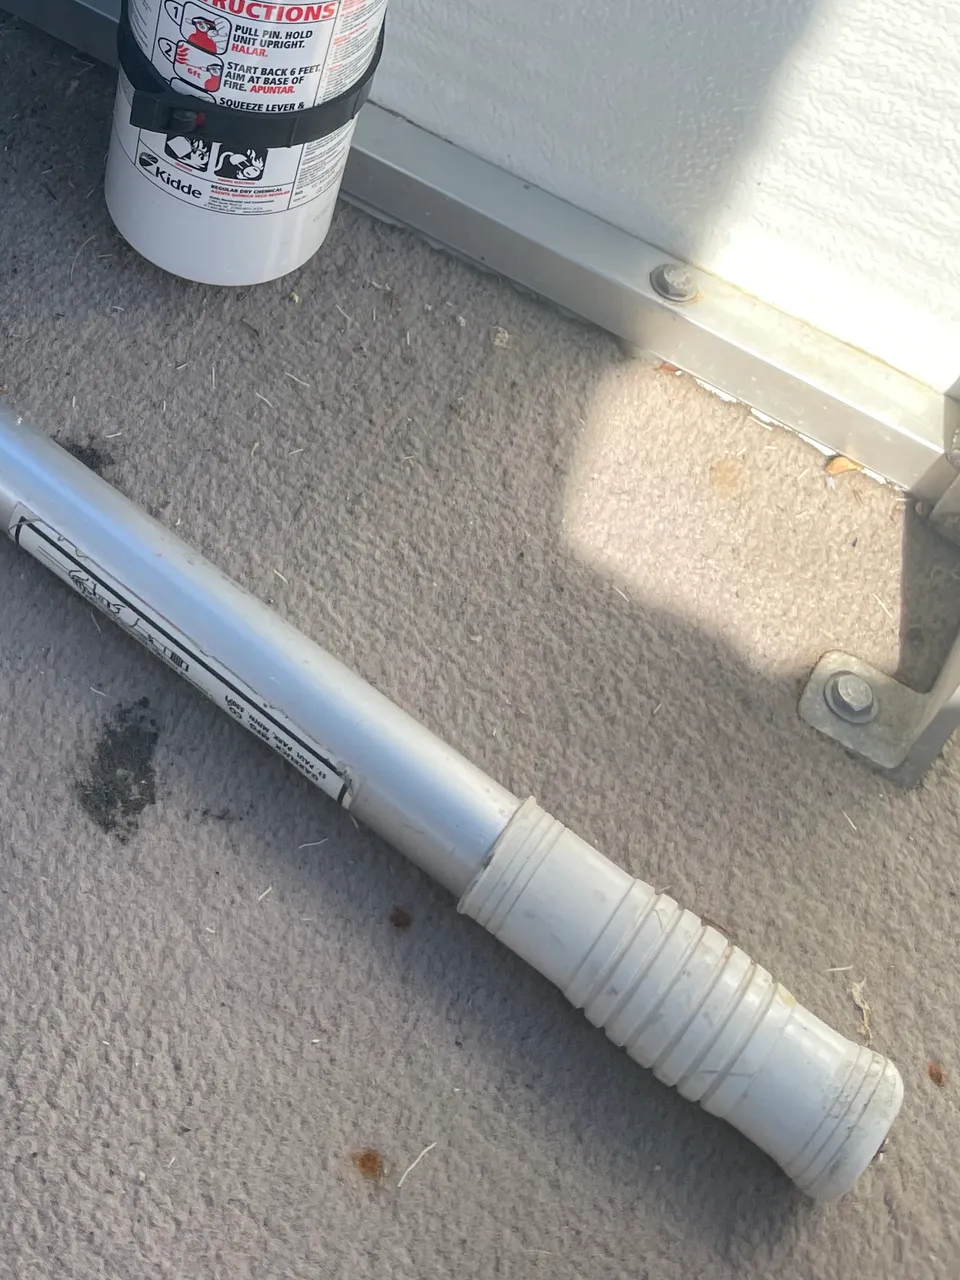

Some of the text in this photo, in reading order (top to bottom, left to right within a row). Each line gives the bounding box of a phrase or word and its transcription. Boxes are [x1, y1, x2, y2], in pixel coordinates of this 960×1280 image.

[173, 6, 179, 19] 1
[235, 24, 313, 40] PULL PIN. HOLD
[233, 34, 305, 49] UNIT UPRIGHT.
[163, 42, 172, 57] 2
[231, 43, 268, 58] HALAR.
[227, 61, 321, 77] START BACK 6 FEET.
[224, 71, 305, 86] AIM AT BASE OF
[223, 80, 295, 95] FIRE. APUNTAR.
[219, 96, 305, 112] SQUEEZE LEVER &
[155, 166, 202, 199] Kidde
[211, 184, 239, 193] REGULAR
[253, 187, 283, 195] CHEMICAL
[297, 752, 315, 770] PAUL
